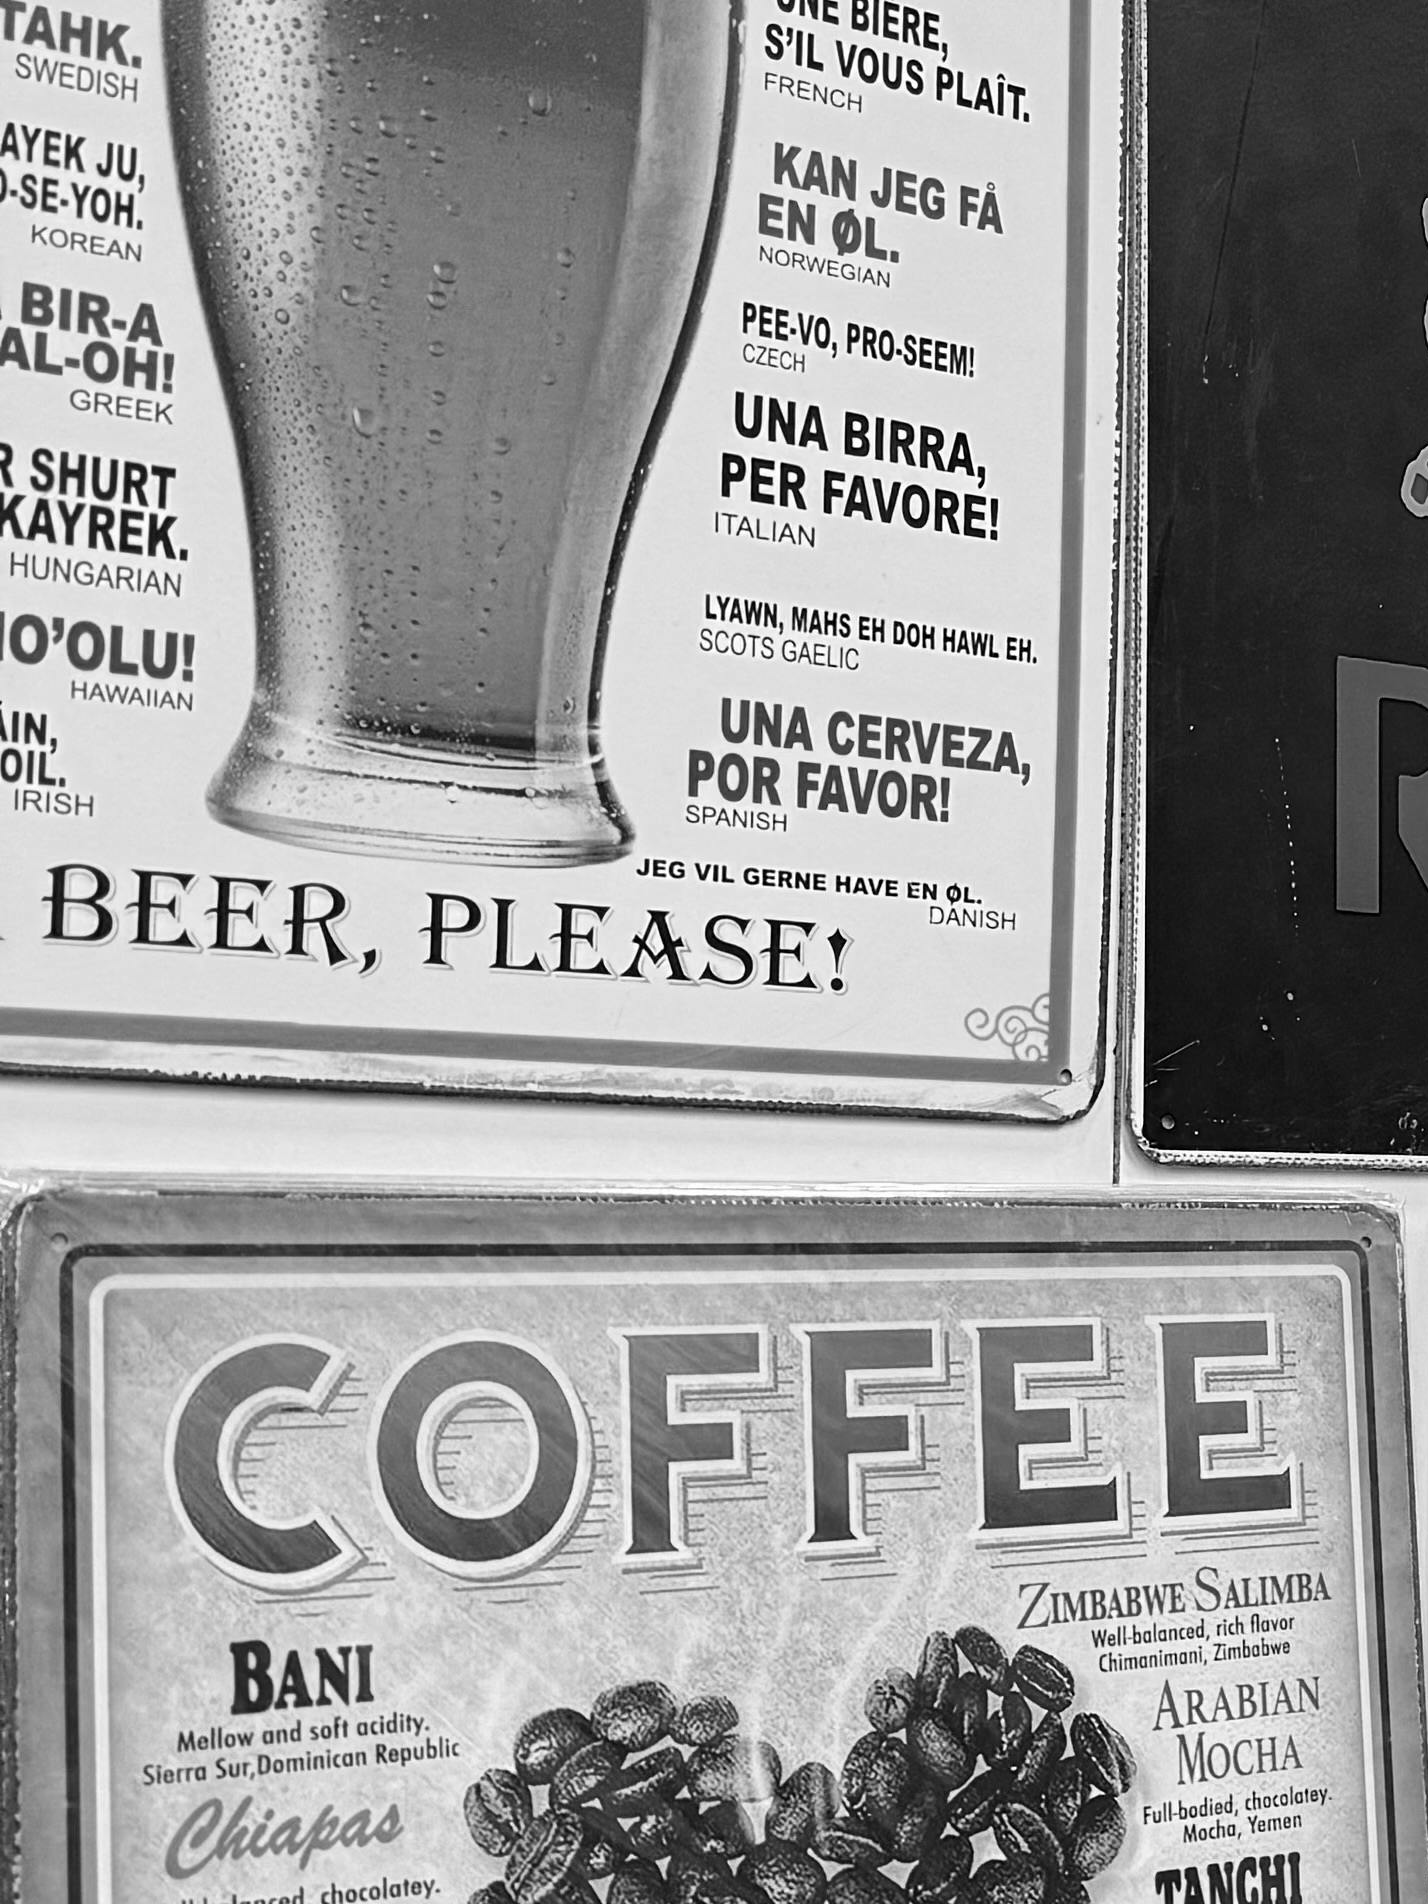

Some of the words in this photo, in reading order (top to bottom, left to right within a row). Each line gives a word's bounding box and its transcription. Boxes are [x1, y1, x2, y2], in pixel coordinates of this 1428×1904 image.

[14, 54, 139, 102] SWEDISH
[836, 41, 924, 96] VOUS
[935, 60, 1031, 124] PLAÎT.
[758, 245, 892, 288] NORWEGIAN
[44, 862, 379, 977] BEER,
[421, 889, 854, 998] PLEASE!
[163, 1313, 1318, 1592] COFFEE
[1016, 1581, 1186, 1630] ZIMBABWE
[1193, 1566, 1331, 1613] SALIMBA
[229, 1640, 375, 1715] BANI
[177, 1725, 255, 1754] Mellow
[261, 1722, 302, 1746] and
[309, 1716, 349, 1743] soft
[357, 1712, 431, 1739] acidity.
[165, 1796, 404, 1880] Chiapas
